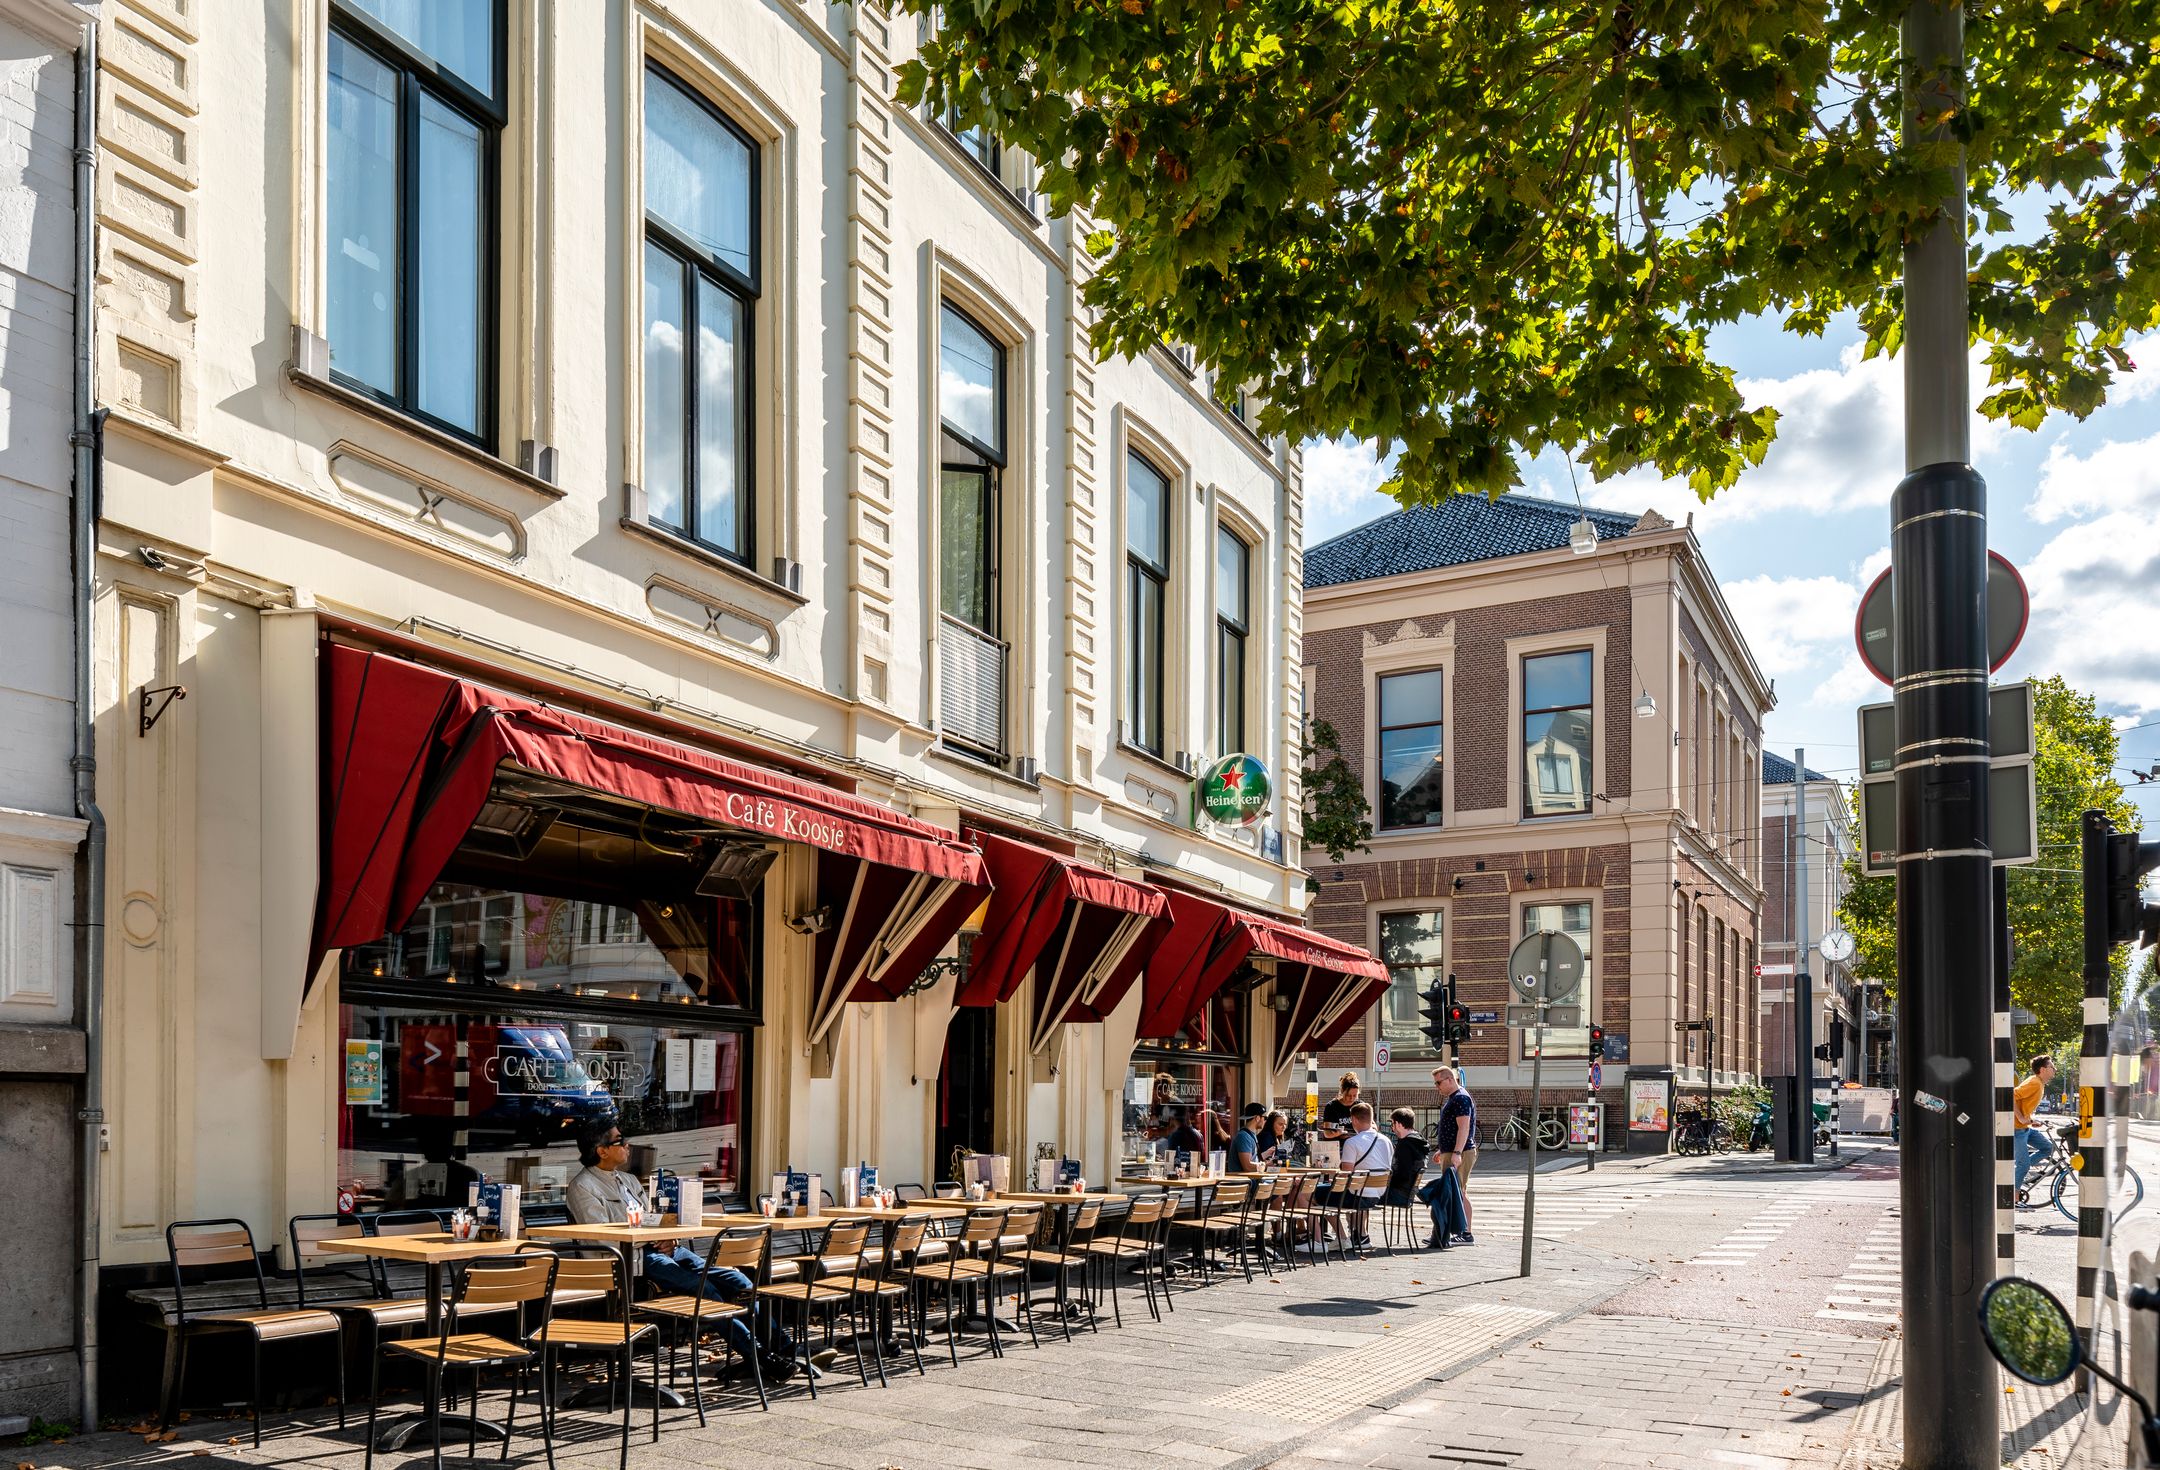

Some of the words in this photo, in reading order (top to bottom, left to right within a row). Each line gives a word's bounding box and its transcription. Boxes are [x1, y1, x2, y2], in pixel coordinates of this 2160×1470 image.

[1206, 794, 1260, 807] Heineken
[727, 793, 775, 828] Café
[783, 807, 844, 849] Koosje
[1306, 947, 1321, 964] Café
